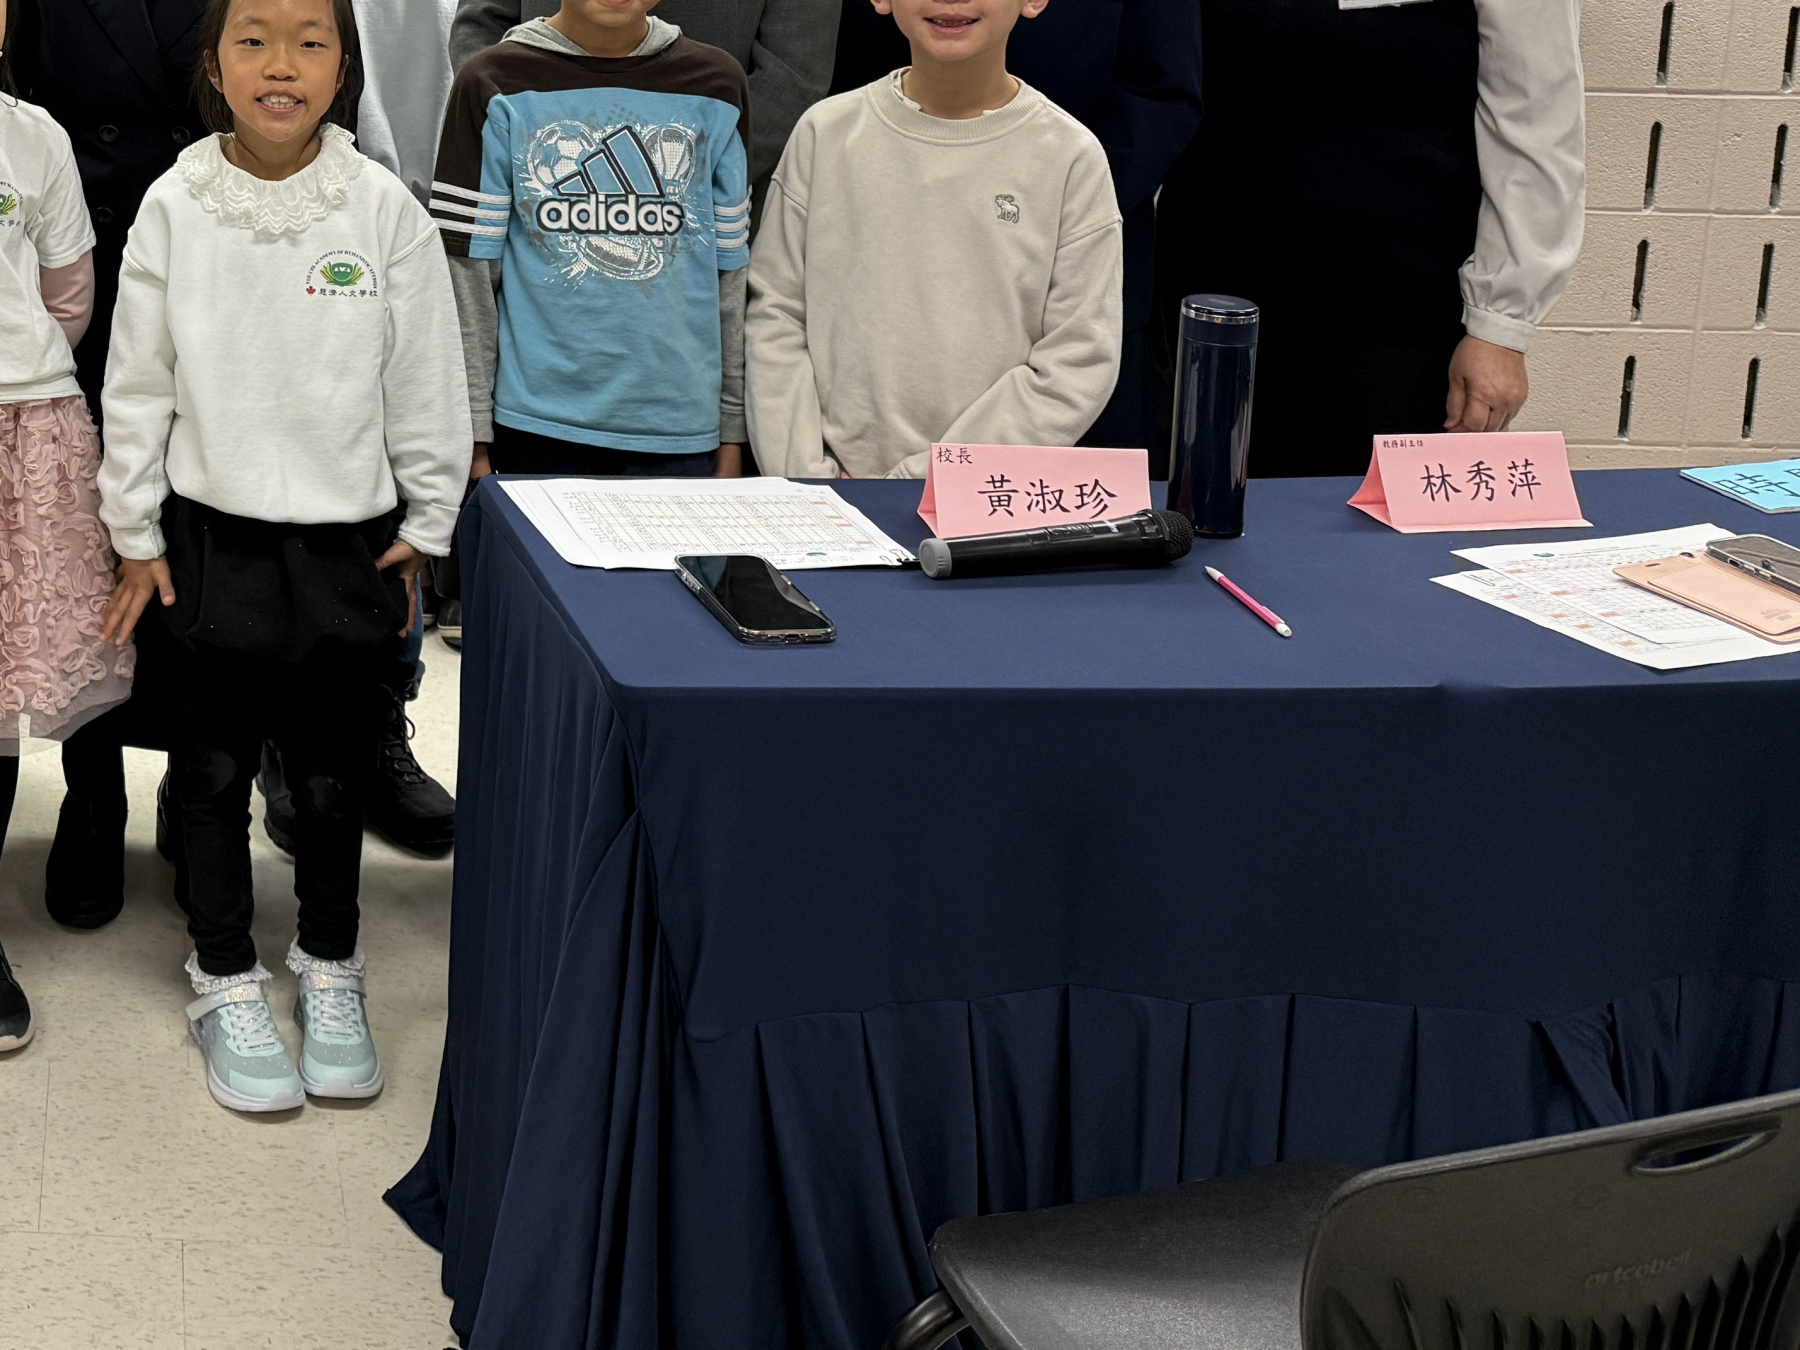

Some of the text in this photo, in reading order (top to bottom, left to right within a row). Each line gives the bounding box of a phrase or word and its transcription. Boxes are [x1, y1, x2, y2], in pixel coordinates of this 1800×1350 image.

[540, 194, 682, 233] adidas
[319, 288, 378, 297] 慈濟人文學校
[936, 447, 973, 464] 校長
[977, 474, 1117, 519] 黃淑珍
[1420, 458, 1542, 502] 林秀萍
